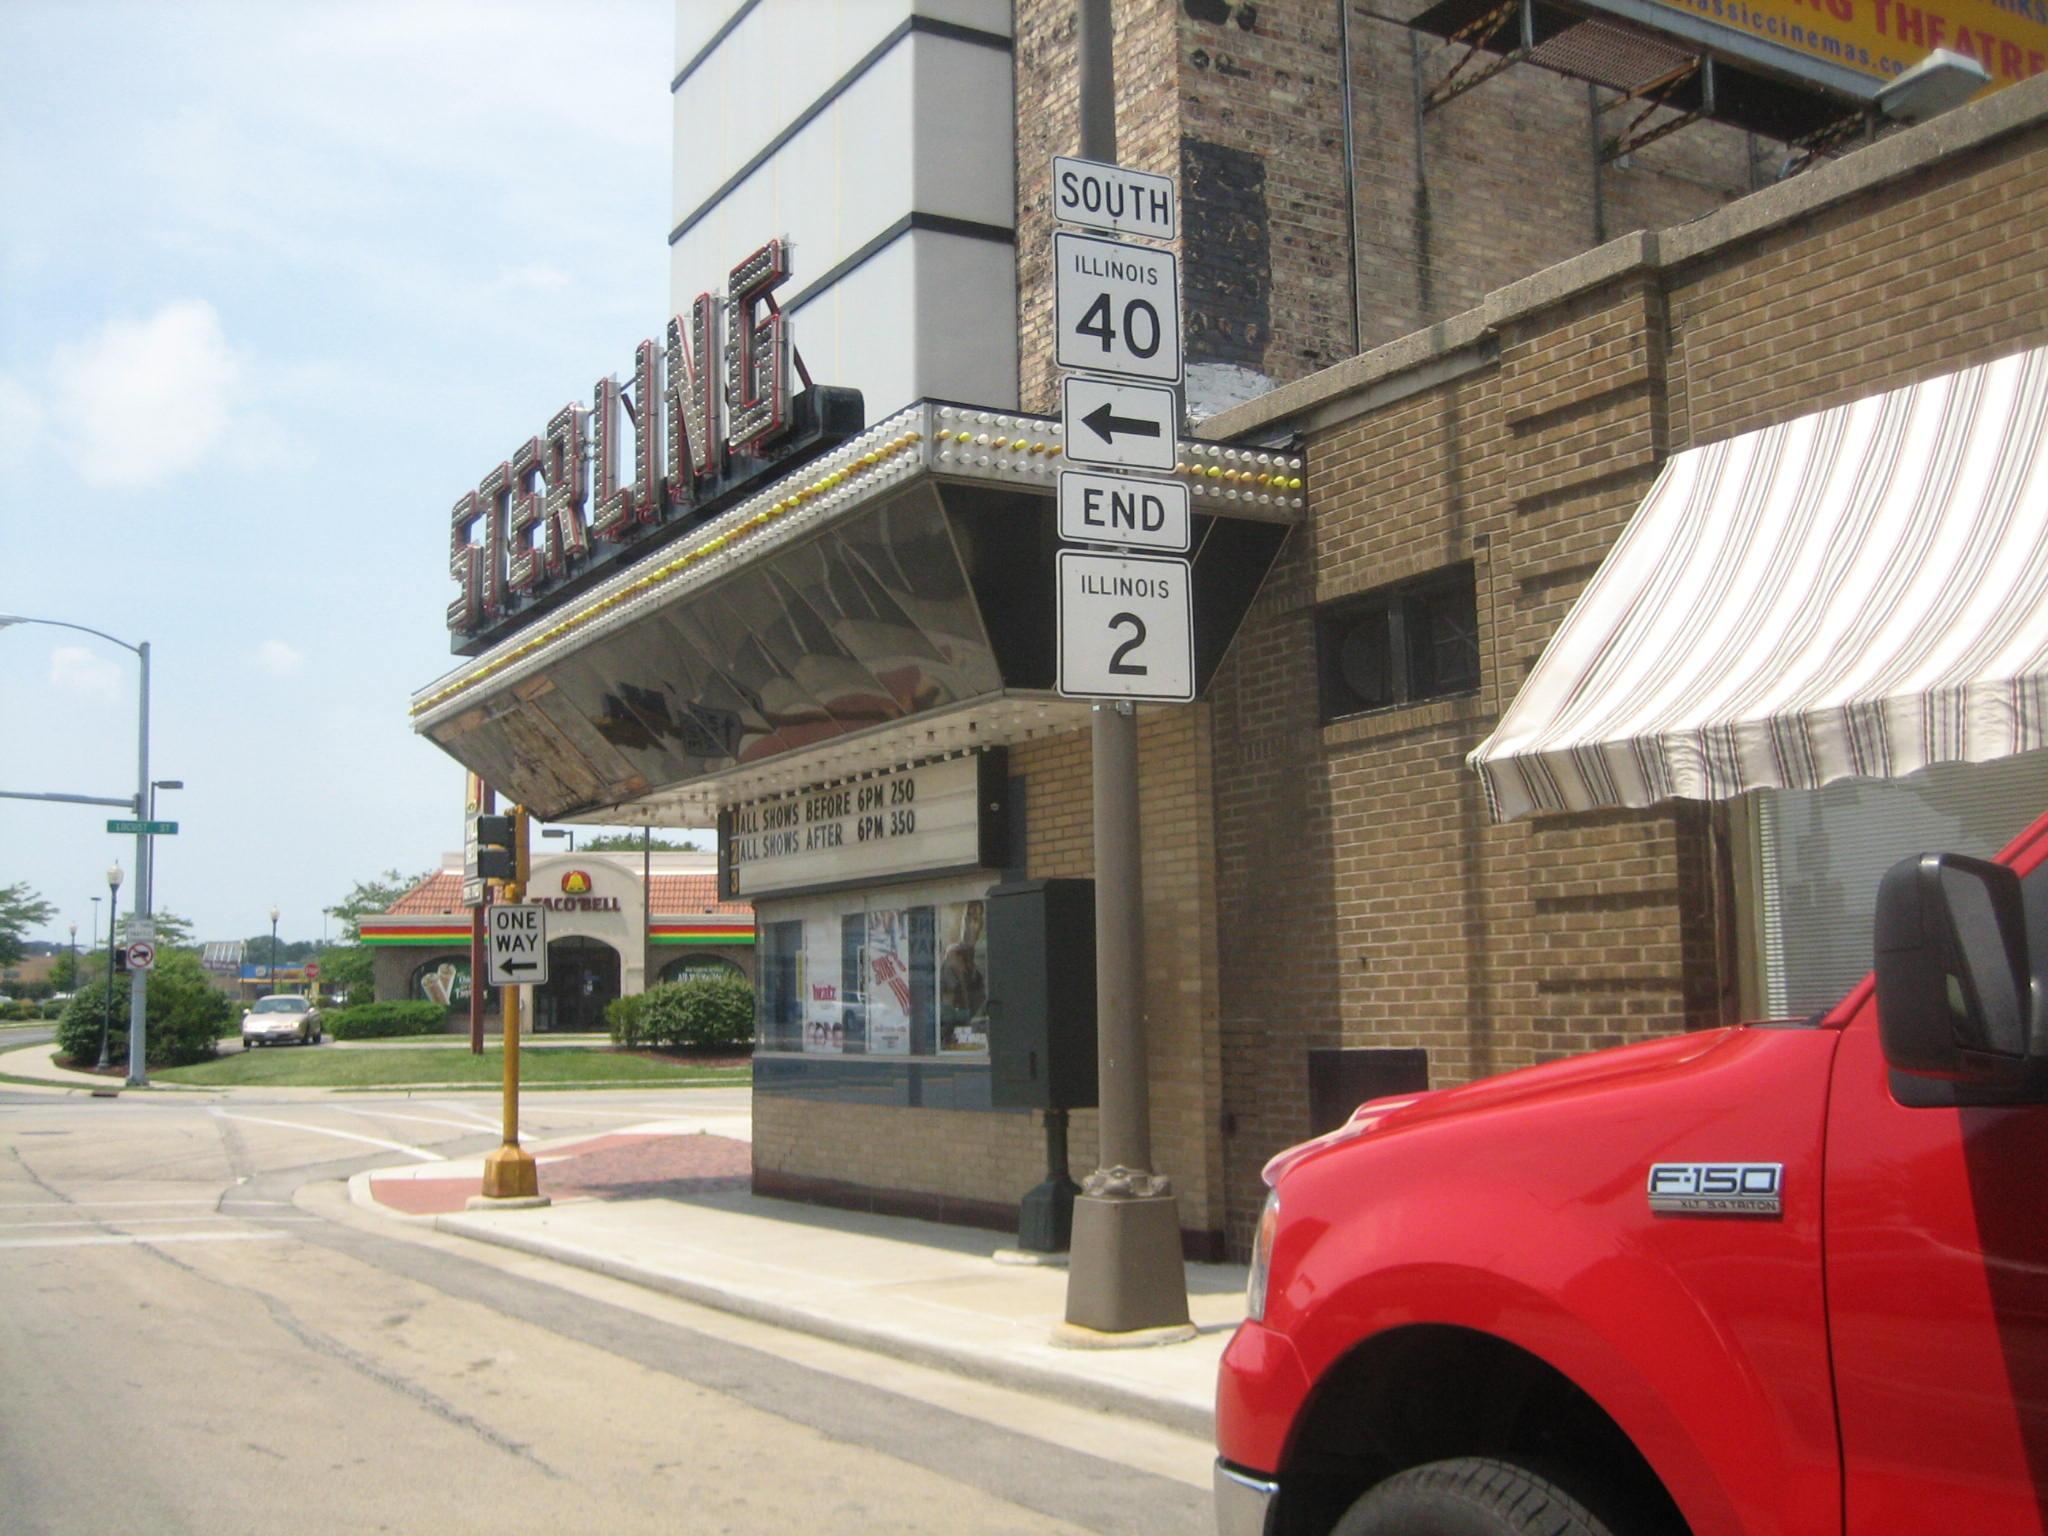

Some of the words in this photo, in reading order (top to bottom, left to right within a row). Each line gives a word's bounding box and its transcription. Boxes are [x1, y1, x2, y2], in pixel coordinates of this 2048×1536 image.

[1061, 171, 1169, 226] SOUTH
[1075, 254, 1159, 286] ILLINOIS
[1075, 292, 1161, 359] 40
[447, 237, 793, 632] STERLING
[1083, 487, 1165, 532] END
[1081, 574, 1169, 599] ILLINOIS
[1107, 611, 1148, 676] 2
[740, 810, 758, 835] ALL
[763, 802, 799, 831] SHOWS
[806, 791, 851, 822] BEFORE
[858, 784, 883, 812] 6PM
[891, 778, 914, 804] 250
[740, 838, 758, 861] ALL
[763, 829, 799, 858] SHOWS
[806, 822, 842, 850] AFTER
[858, 815, 883, 842] 6PM
[891, 809, 915, 836] 350
[497, 911, 537, 930] ONE
[577, 897, 621, 912] BELL
[496, 934, 537, 953] WAY
[1651, 1167, 1776, 1194] F-150
